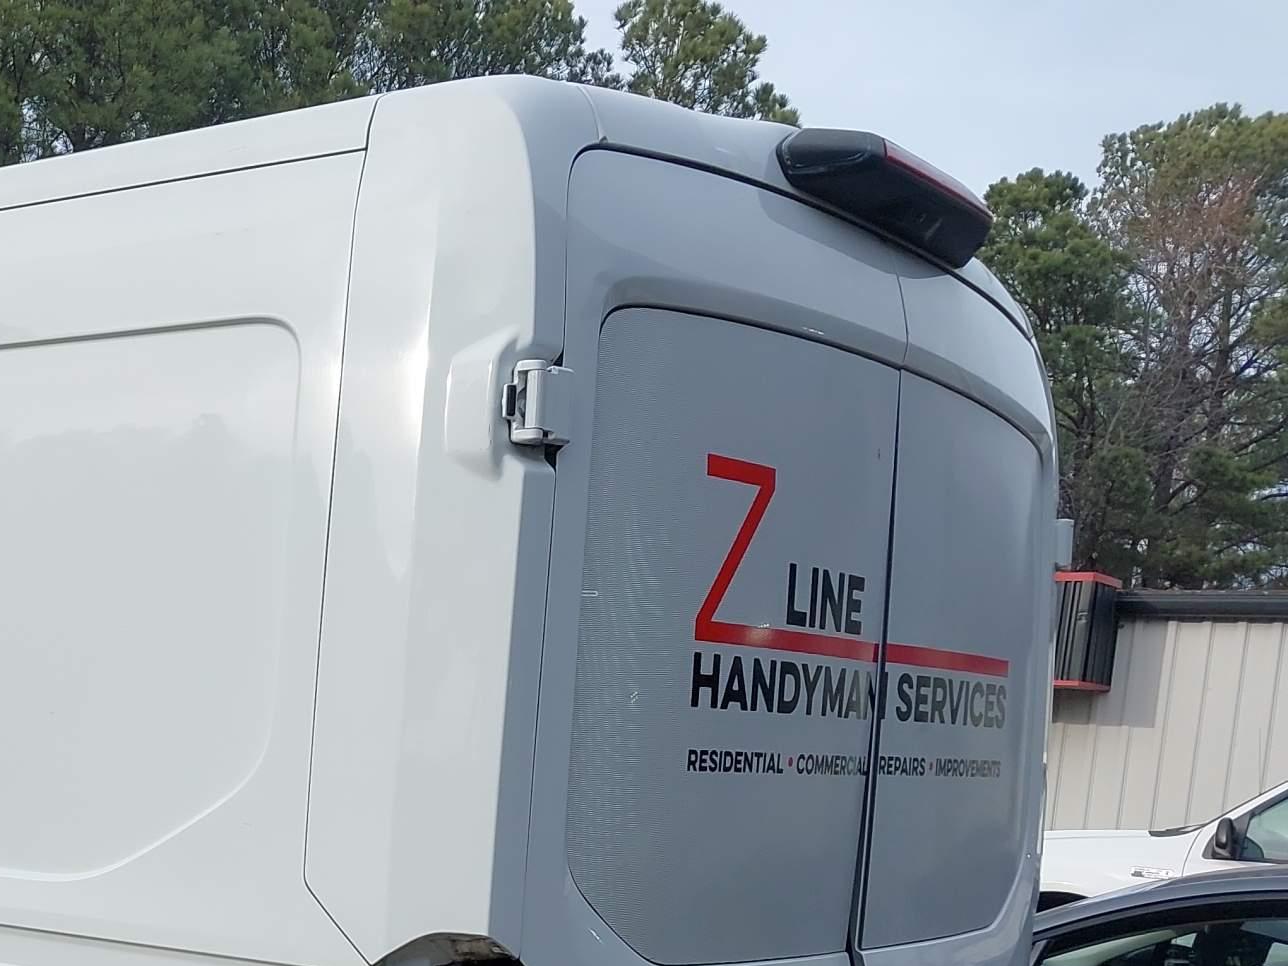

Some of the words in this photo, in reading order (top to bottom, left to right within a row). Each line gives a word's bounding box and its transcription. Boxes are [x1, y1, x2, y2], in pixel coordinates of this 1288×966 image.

[786, 563, 865, 635] LINE
[690, 652, 888, 721] HANDYMAN
[896, 672, 1007, 729] SERVICES
[687, 749, 783, 775] RESIDENTIAL
[796, 753, 869, 777] COMMERCIAL
[879, 756, 926, 777] REPAIRS
[935, 758, 1001, 779] IMPROVEMENTS
